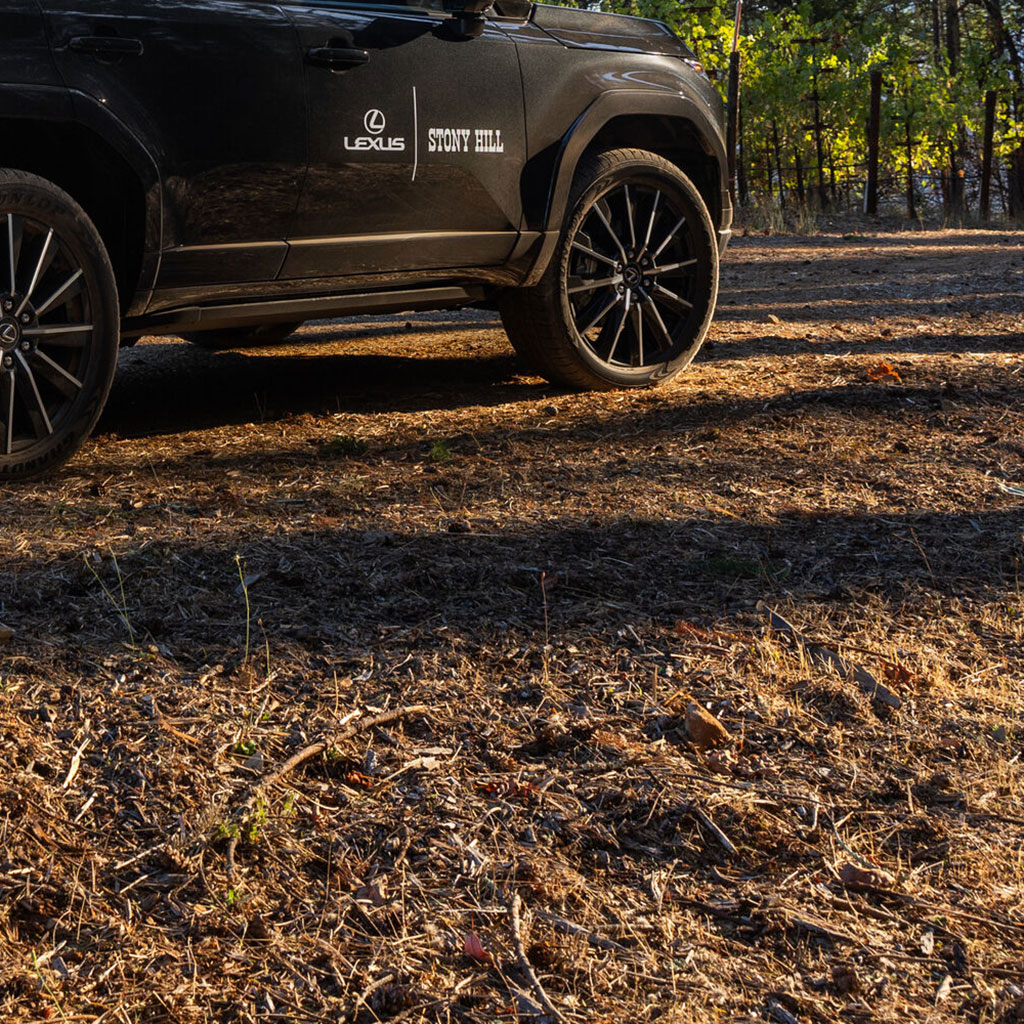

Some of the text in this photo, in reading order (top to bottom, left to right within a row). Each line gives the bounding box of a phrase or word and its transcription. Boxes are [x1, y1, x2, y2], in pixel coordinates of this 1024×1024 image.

[344, 136, 405, 151] LEXUS
[428, 128, 504, 153] STONY HILL
